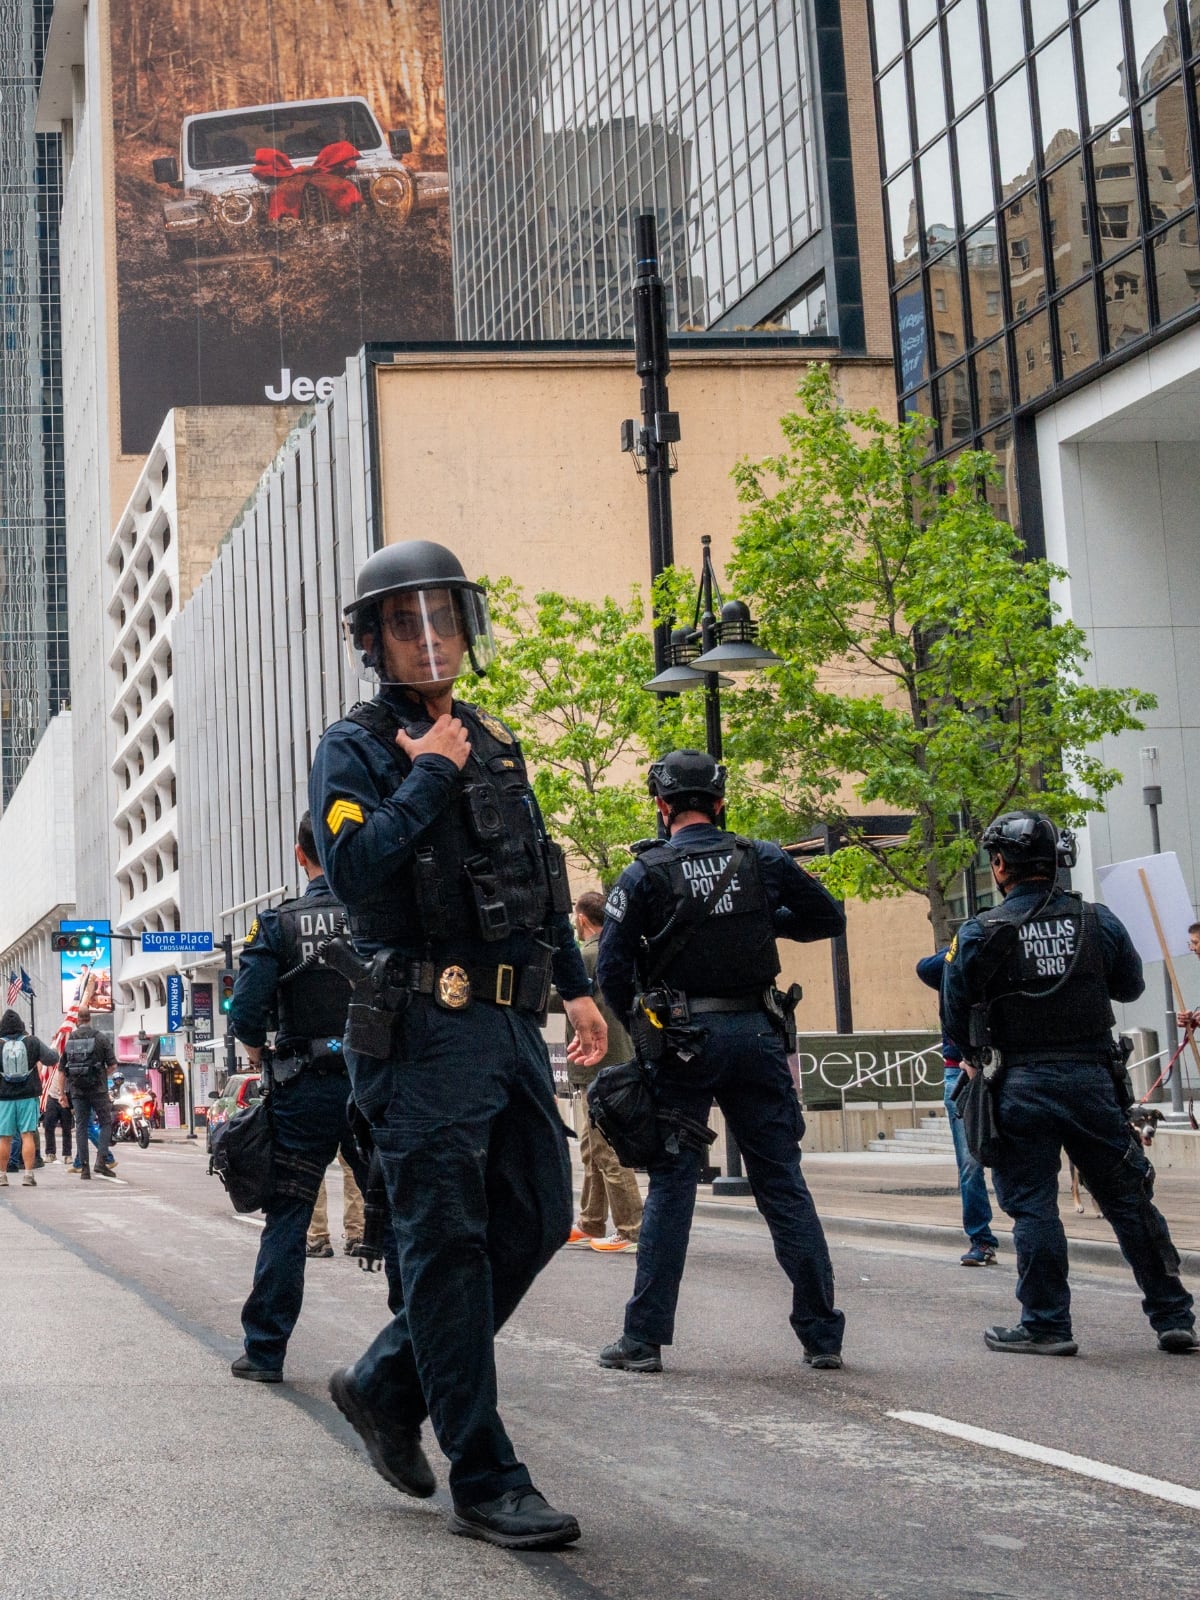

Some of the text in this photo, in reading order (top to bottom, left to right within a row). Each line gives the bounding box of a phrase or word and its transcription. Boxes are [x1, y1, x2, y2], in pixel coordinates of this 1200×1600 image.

[264, 368, 334, 401] Jee
[145, 933, 210, 945] Stone Place
[1018, 919, 1076, 941] DALLAS
[1023, 937, 1076, 959] POLICE
[1036, 956, 1067, 977] SRG
[171, 977, 179, 1017] PARKING
[798, 1050, 947, 1089] PERIDO
